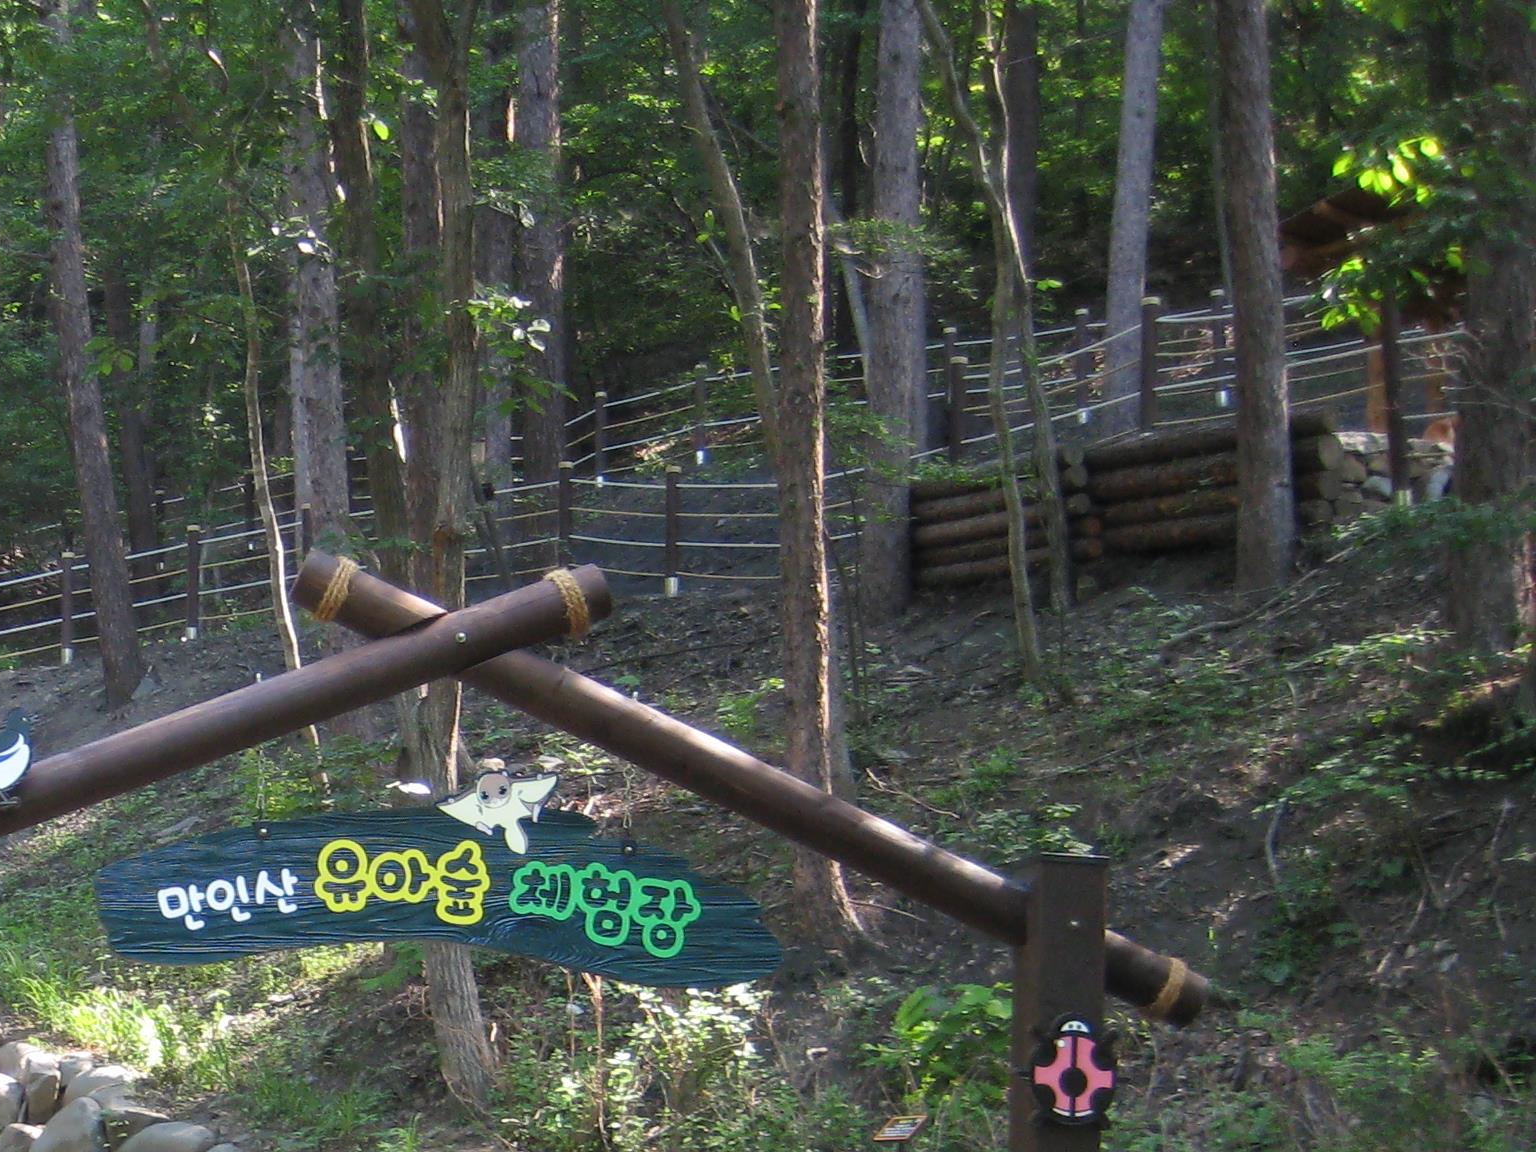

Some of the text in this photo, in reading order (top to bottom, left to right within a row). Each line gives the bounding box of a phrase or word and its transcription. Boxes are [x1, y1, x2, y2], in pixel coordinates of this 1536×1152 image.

[158, 840, 701, 958] 만인산 유아숲 체험장
